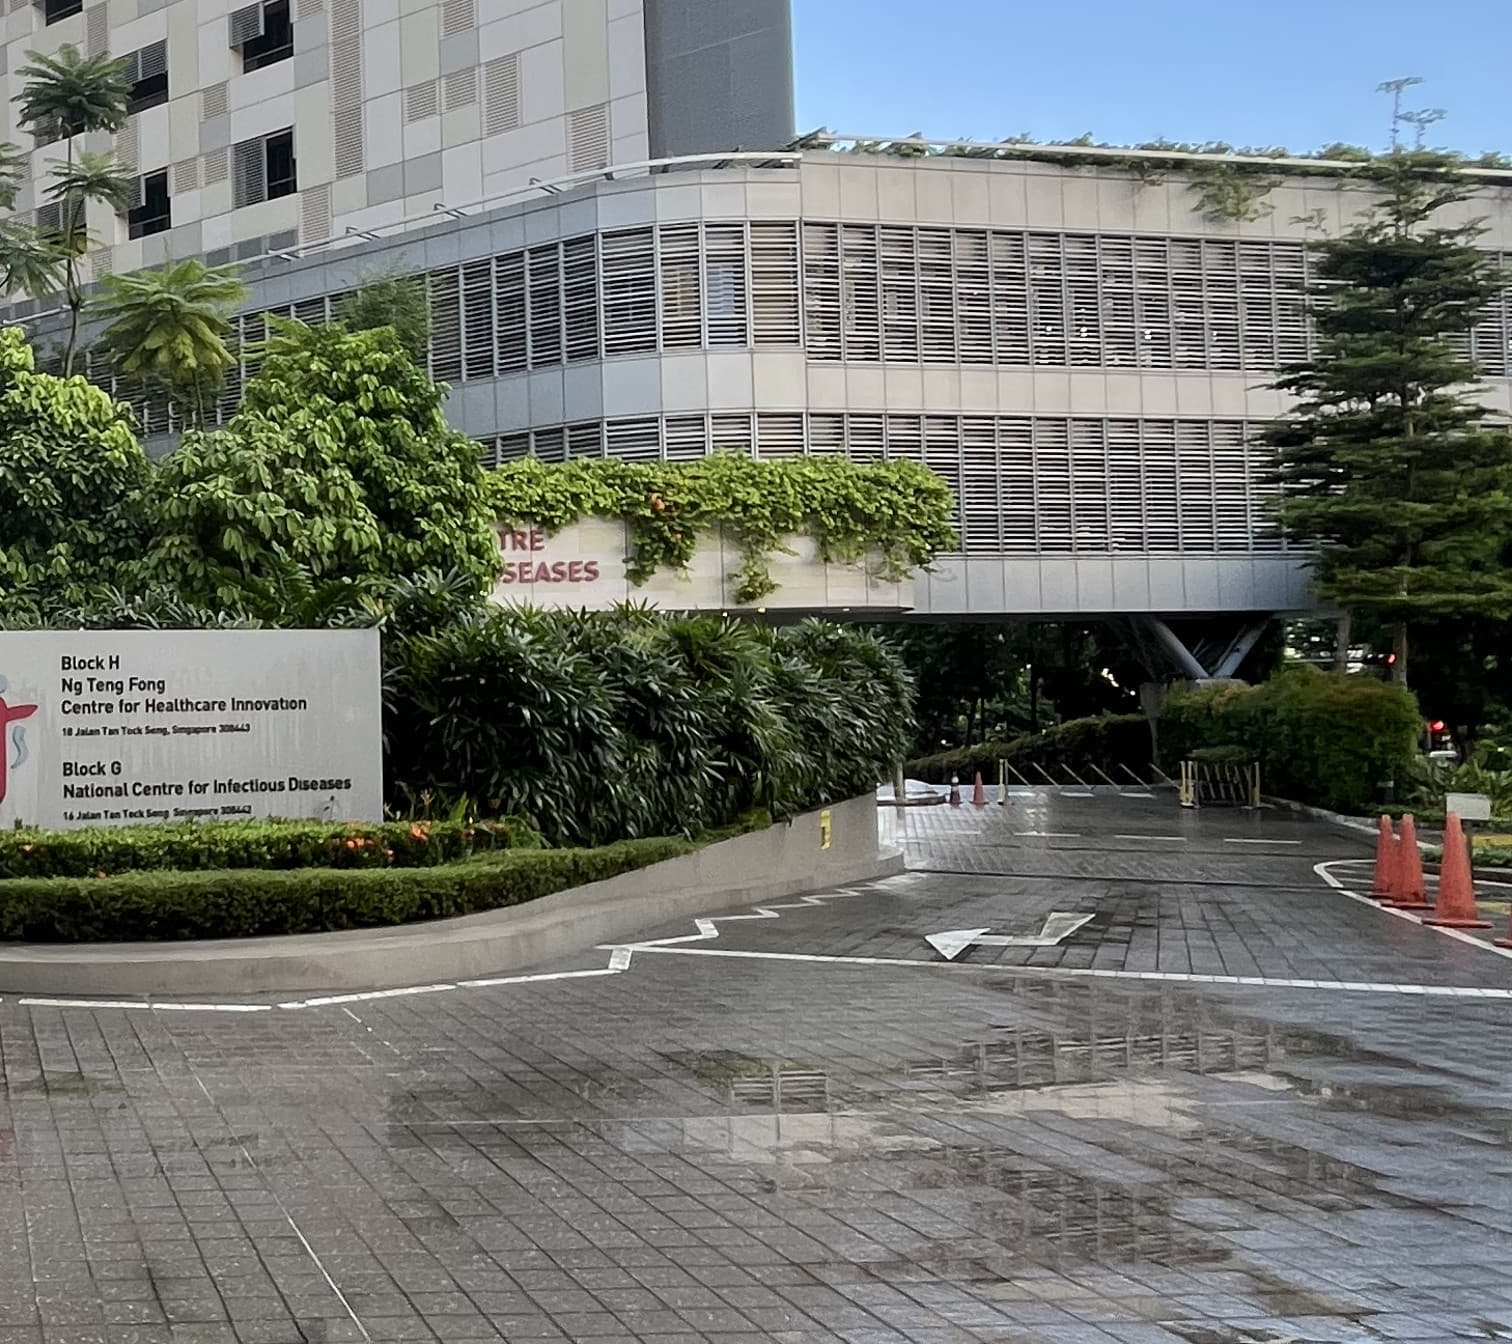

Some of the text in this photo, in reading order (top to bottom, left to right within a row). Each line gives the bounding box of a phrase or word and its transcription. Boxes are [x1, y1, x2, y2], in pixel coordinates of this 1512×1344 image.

[496, 529, 545, 551] TRE
[502, 560, 600, 584] SEASES
[61, 655, 120, 671] Block H
[61, 677, 166, 695] Ng Teng Fong
[61, 697, 308, 715] Centre for Healthcare Innovation
[75, 727, 100, 736] Jalan
[102, 726, 119, 736] Tan
[121, 726, 143, 736] Tock
[172, 724, 217, 735] Singapore
[62, 761, 122, 777] Block G
[63, 777, 352, 798] National Centre for Infectious Diseases
[76, 810, 102, 820] Jalan
[104, 810, 121, 819] Tan
[123, 809, 145, 819] Tock
